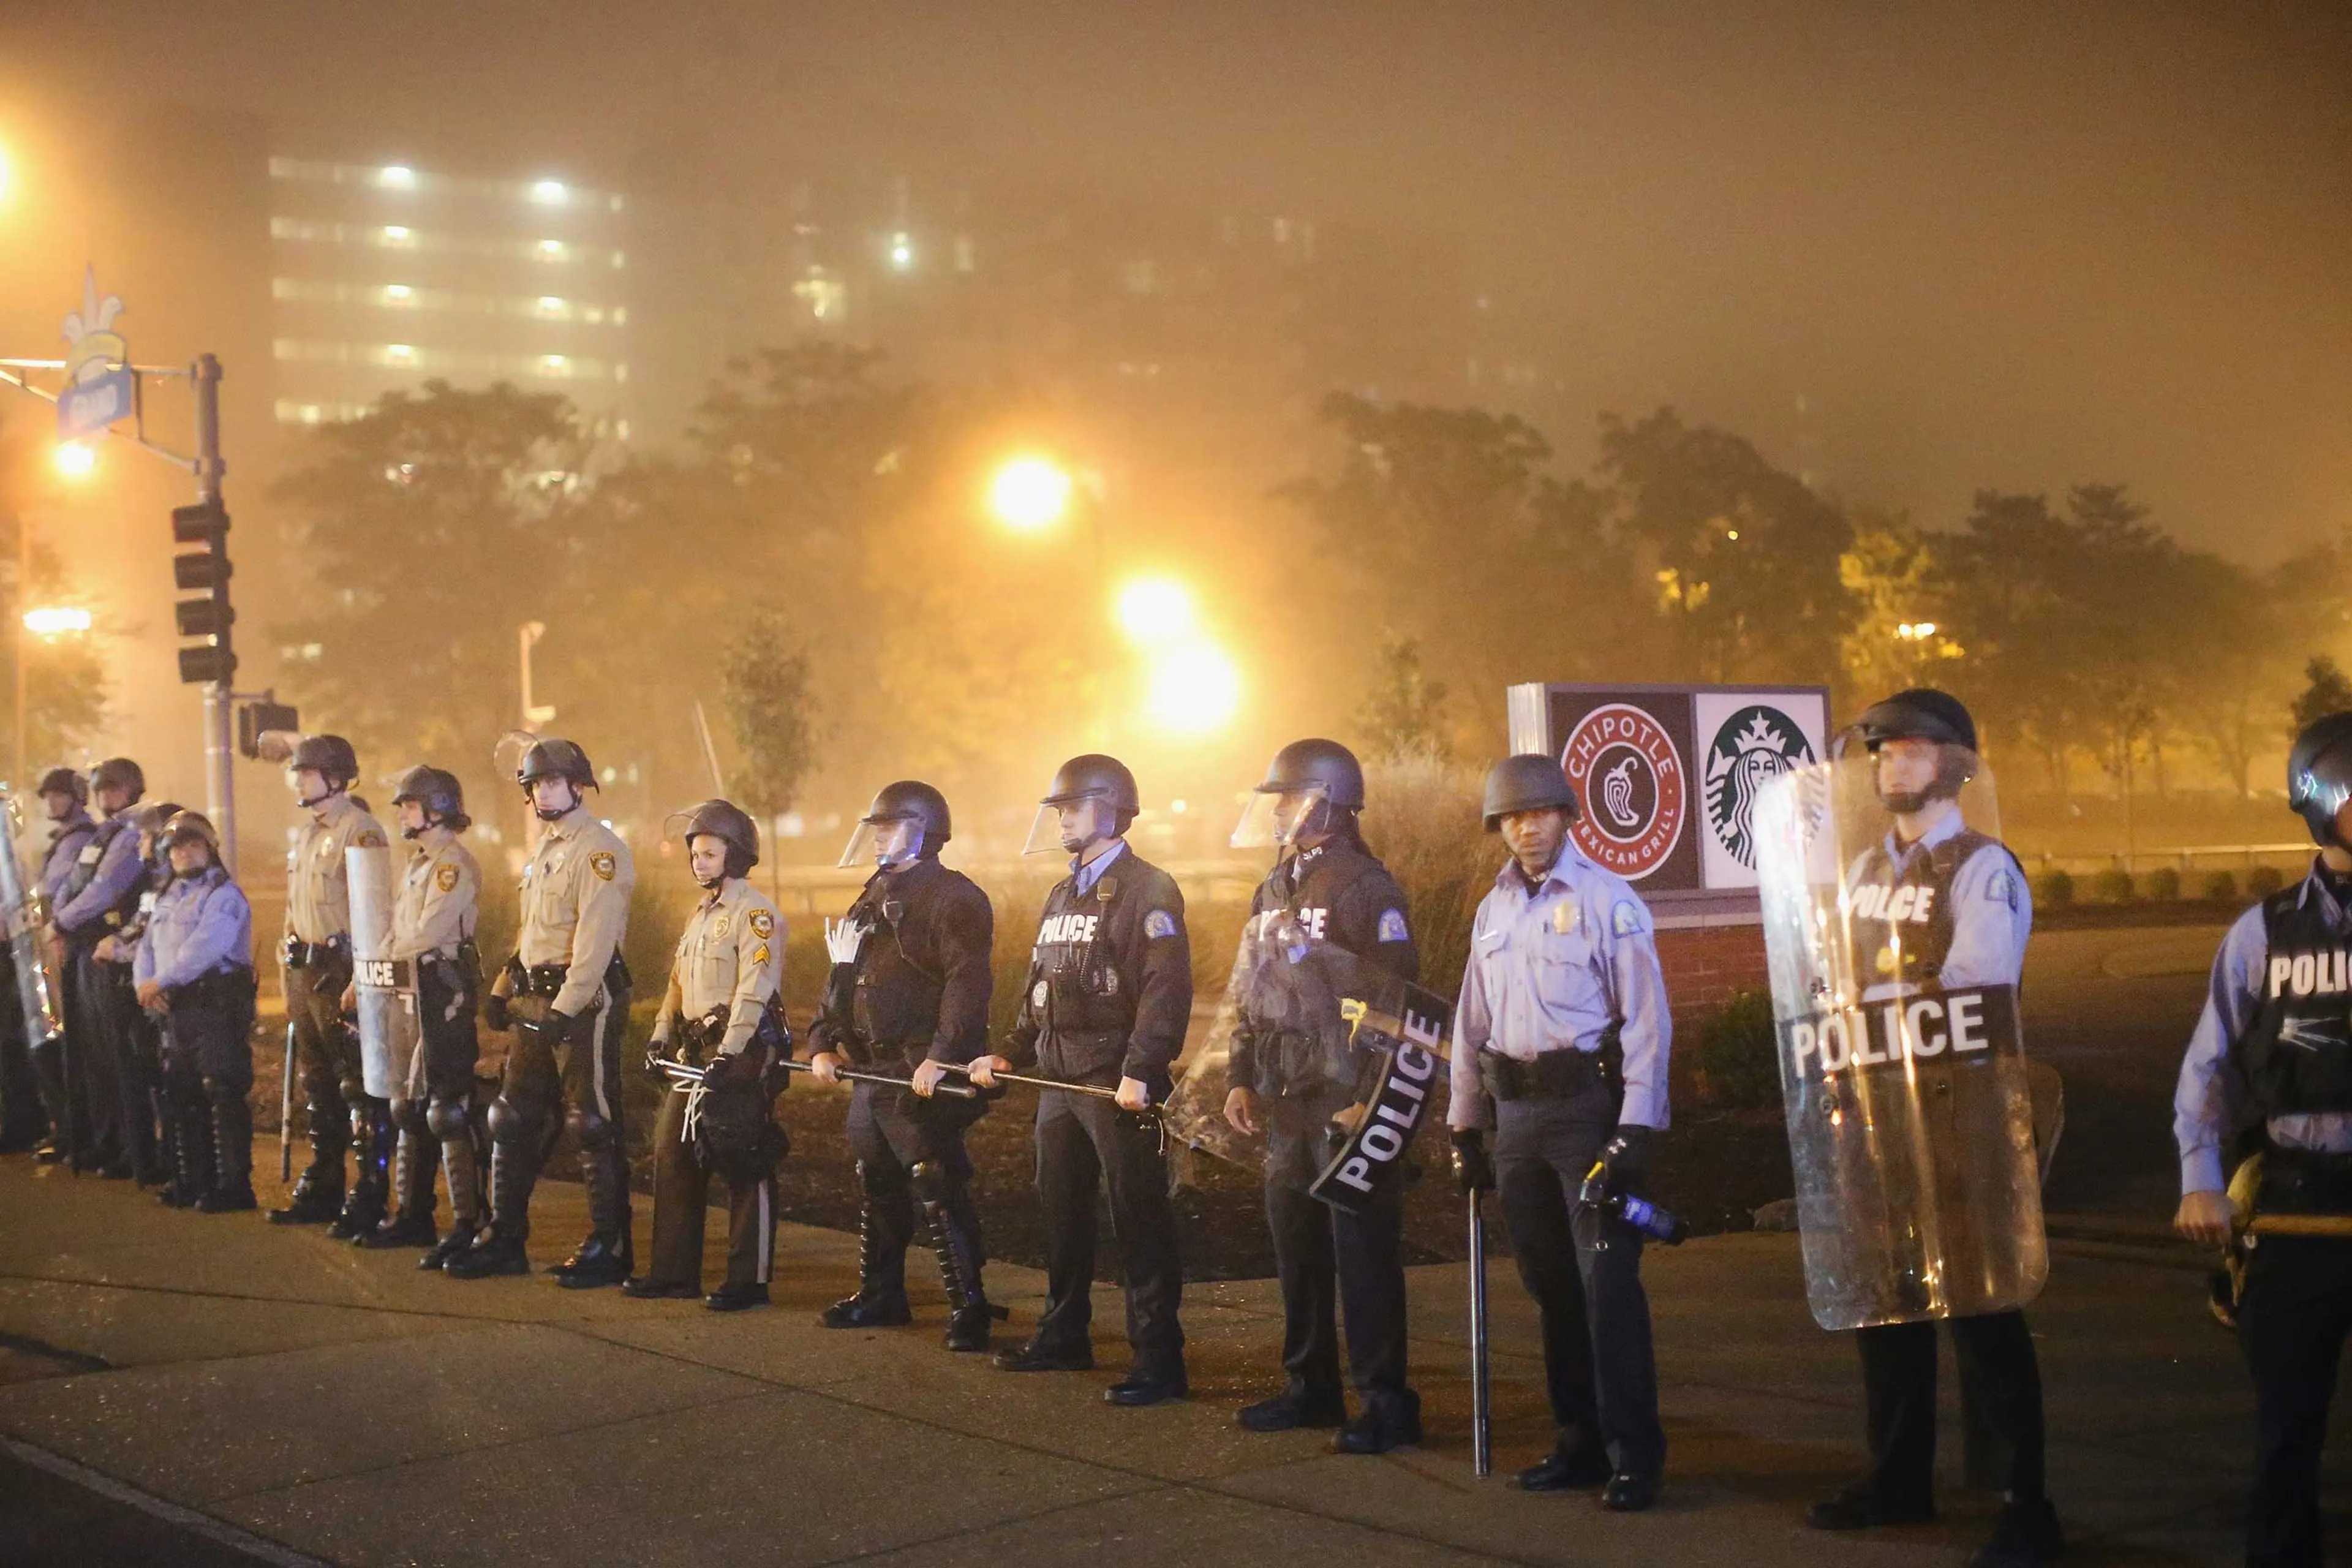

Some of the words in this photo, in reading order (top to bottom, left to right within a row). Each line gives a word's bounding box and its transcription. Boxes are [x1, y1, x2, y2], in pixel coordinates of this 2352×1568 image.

[1569, 716, 1675, 779] CHIPOTLE
[1642, 808, 1675, 858] GRILL
[1037, 914, 1098, 945] POLICE
[2270, 951, 2352, 999] POLI
[1792, 994, 1989, 1079] POLICE
[1335, 1008, 1441, 1194] POLICE
